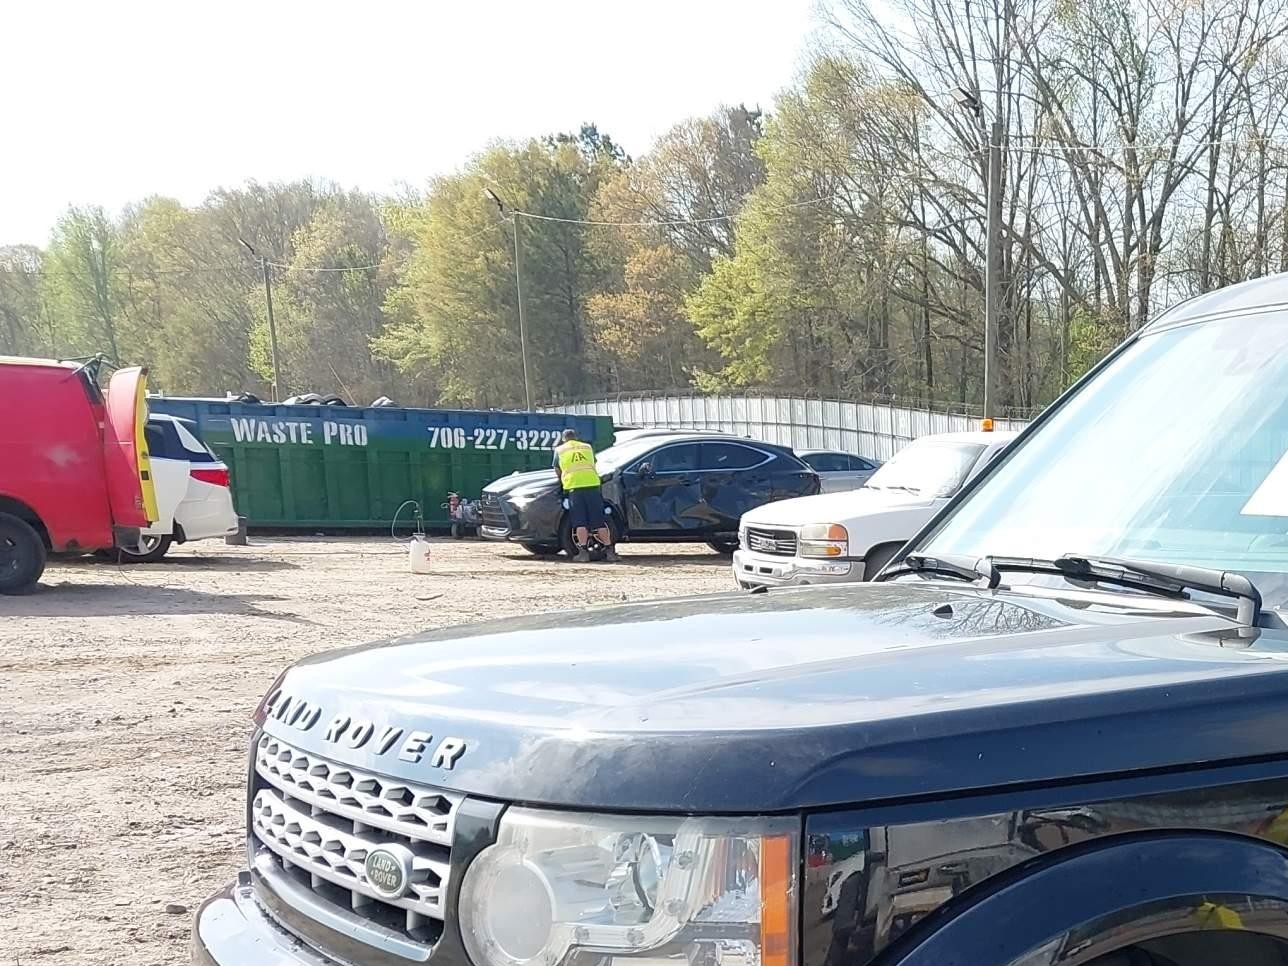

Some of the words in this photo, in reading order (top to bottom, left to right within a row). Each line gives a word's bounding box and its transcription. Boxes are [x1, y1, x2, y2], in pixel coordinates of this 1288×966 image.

[230, 418, 314, 444] WASTE
[323, 421, 367, 446] PRO
[427, 427, 561, 450] 706-227-3222
[325, 713, 467, 770] ROVER
[373, 855, 392, 872] LAND
[374, 869, 397, 887] ROVER
